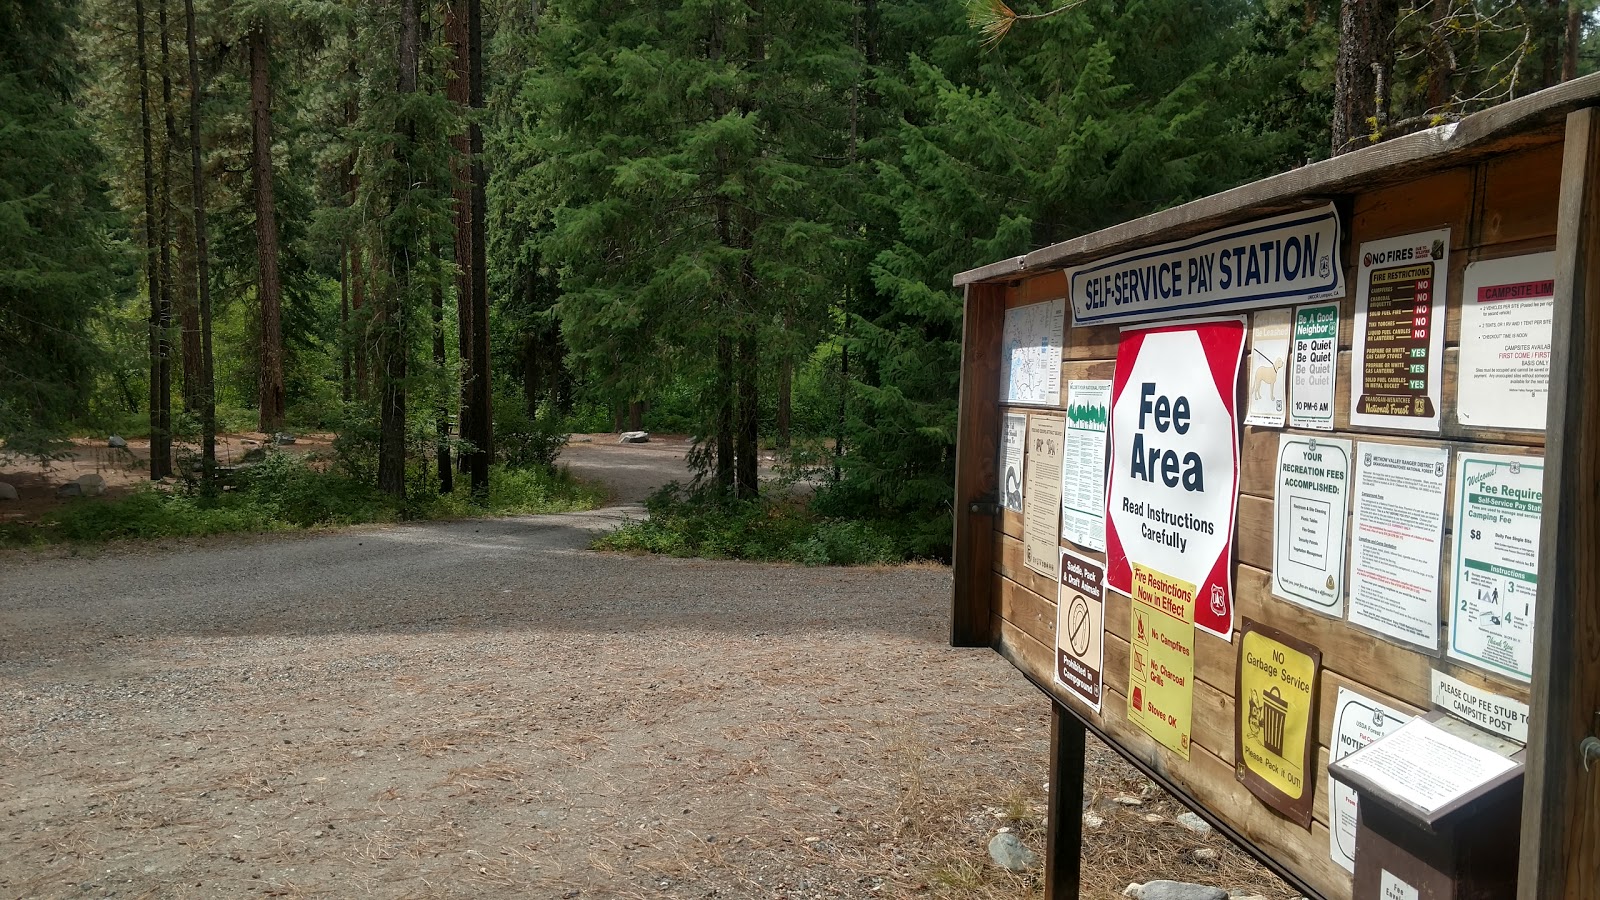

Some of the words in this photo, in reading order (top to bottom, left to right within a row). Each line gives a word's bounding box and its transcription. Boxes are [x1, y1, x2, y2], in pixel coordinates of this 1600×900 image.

[1372, 253, 1385, 264] NO
[1387, 248, 1413, 262] FIRES
[1085, 260, 1183, 310] SELF-SERVICE
[1188, 253, 1216, 295] PAY
[1219, 232, 1320, 290] STATION
[1374, 274, 1386, 282] FIRE
[1388, 268, 1430, 280] RESTRICTIONS
[1418, 281, 1428, 289] NO
[1486, 285, 1532, 299] CAMPSITE
[1417, 294, 1427, 302] NO
[1417, 306, 1427, 314] NO
[1299, 314, 1306, 324] Be
[1310, 313, 1314, 323] A
[1317, 311, 1334, 323] Good
[1416, 318, 1426, 326] NO
[1264, 328, 1288, 336] Leashed
[1298, 324, 1328, 337] Neighbor
[1415, 330, 1425, 338] NO
[1298, 341, 1307, 351] Be
[1311, 340, 1331, 351] Quiet
[1297, 352, 1307, 362] Be
[1310, 352, 1331, 363] Quiet
[1411, 349, 1426, 357] YES
[1296, 364, 1306, 374] Be
[1310, 364, 1330, 374] Quiet
[1410, 364, 1425, 373] YES
[1296, 376, 1305, 386] Be
[1309, 375, 1329, 386] Quiet
[1410, 380, 1424, 389] YES
[1138, 383, 1191, 436] Fee
[1296, 402, 1303, 410] 10
[1319, 402, 1328, 411] AM
[1366, 403, 1389, 414] National
[1390, 404, 1409, 415] Forest
[1130, 433, 1205, 493] Area
[1303, 452, 1322, 462] YOUR
[1283, 463, 1325, 477] RECREATION
[1327, 470, 1344, 480] FEES
[1467, 464, 1497, 486] Welcome!
[1285, 478, 1340, 494] ACCOMPLISHED:
[1480, 482, 1498, 494] Fee
[1502, 485, 1542, 501] Require
[1478, 497, 1513, 508] Self-Service
[1515, 502, 1526, 511] Pay
[1123, 496, 1144, 517] Read
[1147, 503, 1214, 535] Instructions
[1468, 510, 1497, 523] Camping
[1500, 515, 1512, 524] Fee
[1142, 523, 1187, 554] Carefully
[1470, 529, 1481, 540] $8
[1294, 546, 1306, 554] Vegetation
[1307, 550, 1322, 558] Management
[1067, 561, 1084, 578] Saddle,
[1084, 568, 1096, 582] Pack
[1464, 570, 1469, 582] 1
[1491, 565, 1526, 579] Instructions
[1064, 571, 1068, 581] &
[1068, 574, 1080, 588] Draft
[1081, 580, 1100, 597] Animals
[1134, 567, 1146, 584] Fire
[1148, 573, 1192, 603] Restrictions
[1508, 581, 1515, 593] 3
[1138, 585, 1153, 603] Now
[1154, 592, 1161, 607] in
[1162, 596, 1185, 618] Effect
[1461, 600, 1467, 611] 2
[1505, 612, 1512, 624] 4
[1152, 628, 1159, 640] No
[1160, 633, 1190, 656] Campfires
[1487, 635, 1502, 647] Thank
[1503, 641, 1513, 651] You
[1273, 650, 1285, 665] NO
[1064, 655, 1086, 677] Prohibited
[1087, 670, 1092, 681] in
[1150, 658, 1158, 671] No
[1160, 665, 1185, 687] Charcoal
[1247, 652, 1278, 677] Garbage
[1281, 668, 1310, 694] Service
[1064, 667, 1093, 694] Campground
[1150, 671, 1164, 687] Grills
[1440, 681, 1462, 700] PLEASE
[1463, 692, 1477, 706] CLIP
[1479, 699, 1492, 712] FEE
[1494, 705, 1518, 721] STUB
[1148, 701, 1166, 722] Stoves
[1168, 715, 1177, 728] OK
[1454, 700, 1487, 723] CAMPSITE
[1490, 716, 1512, 732] POST
[1356, 720, 1367, 730] USDA
[1368, 726, 1381, 736] Forest
[1245, 746, 1263, 764] Please
[1266, 758, 1279, 774] Pack
[1281, 768, 1285, 778] it
[1288, 772, 1301, 789] OUT!
[1345, 796, 1356, 806] From
[1394, 884, 1404, 896] Fee
